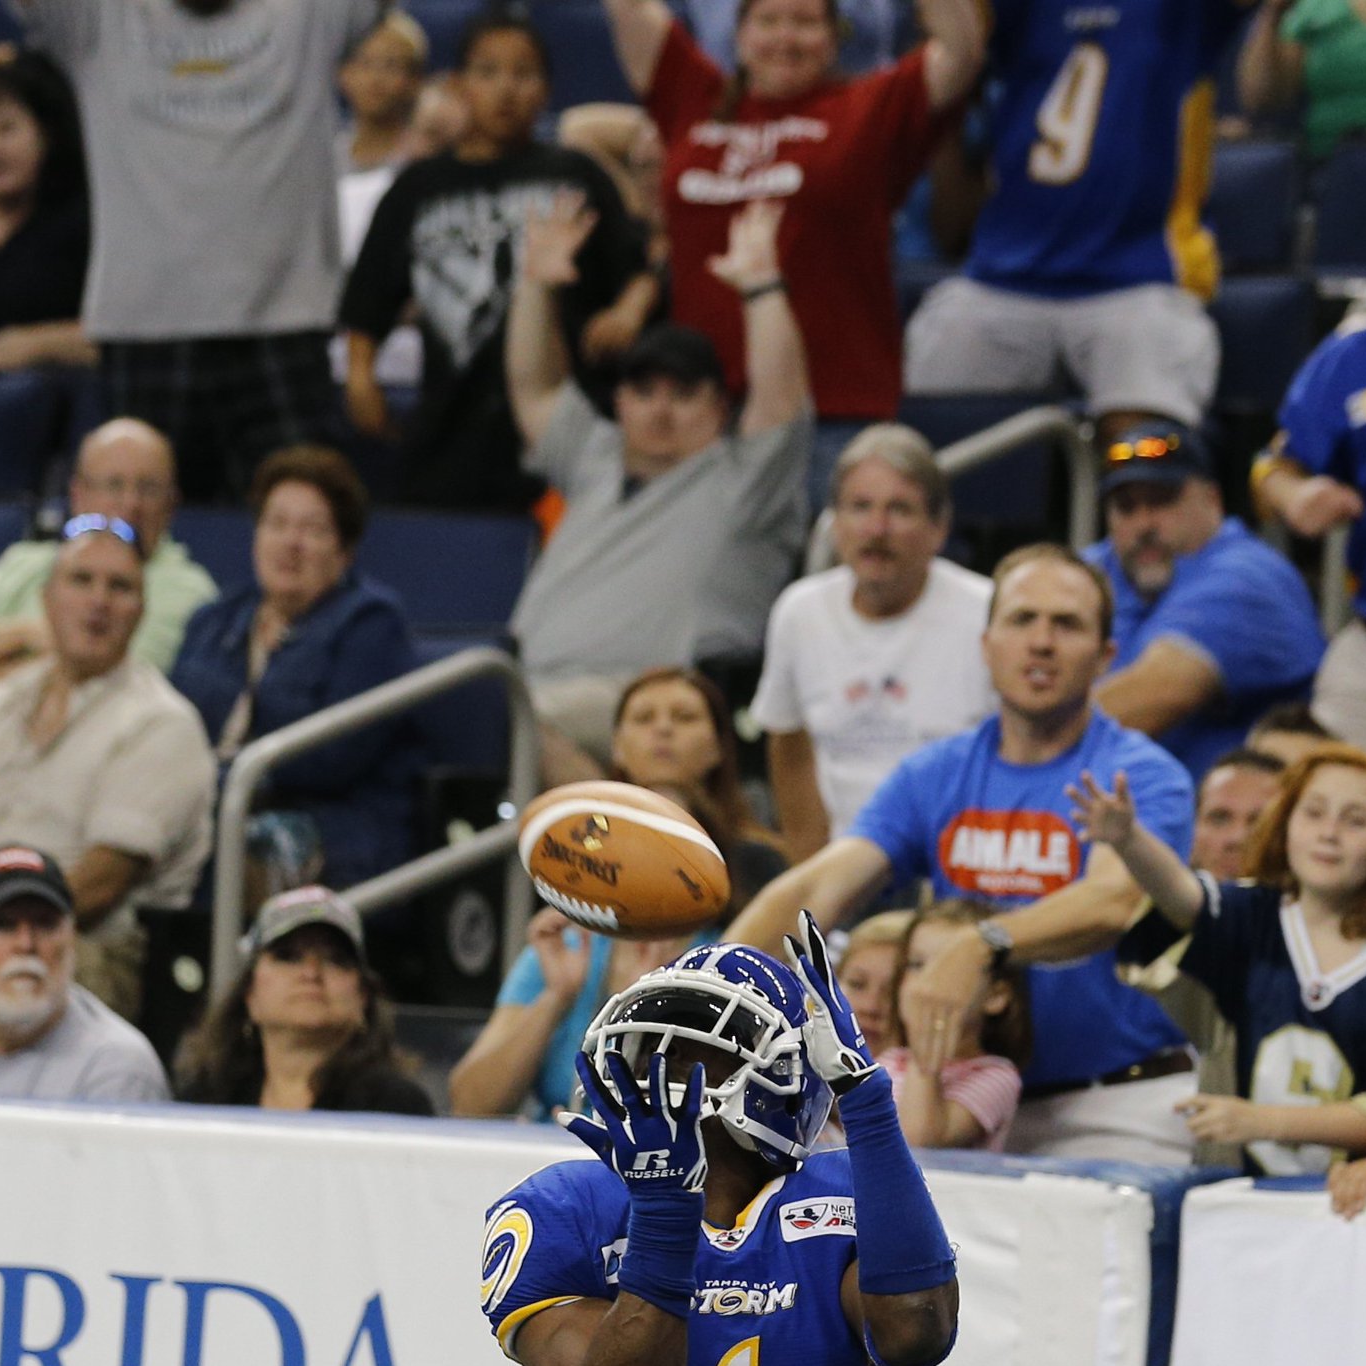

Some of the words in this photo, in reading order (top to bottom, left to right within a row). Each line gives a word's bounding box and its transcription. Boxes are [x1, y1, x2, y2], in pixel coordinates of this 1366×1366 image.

[1026, 40, 1110, 187] 9
[623, 1167, 686, 1179] RUSSELL
[704, 1279, 749, 1289] TAMPA
[753, 1280, 776, 1291] BAY
